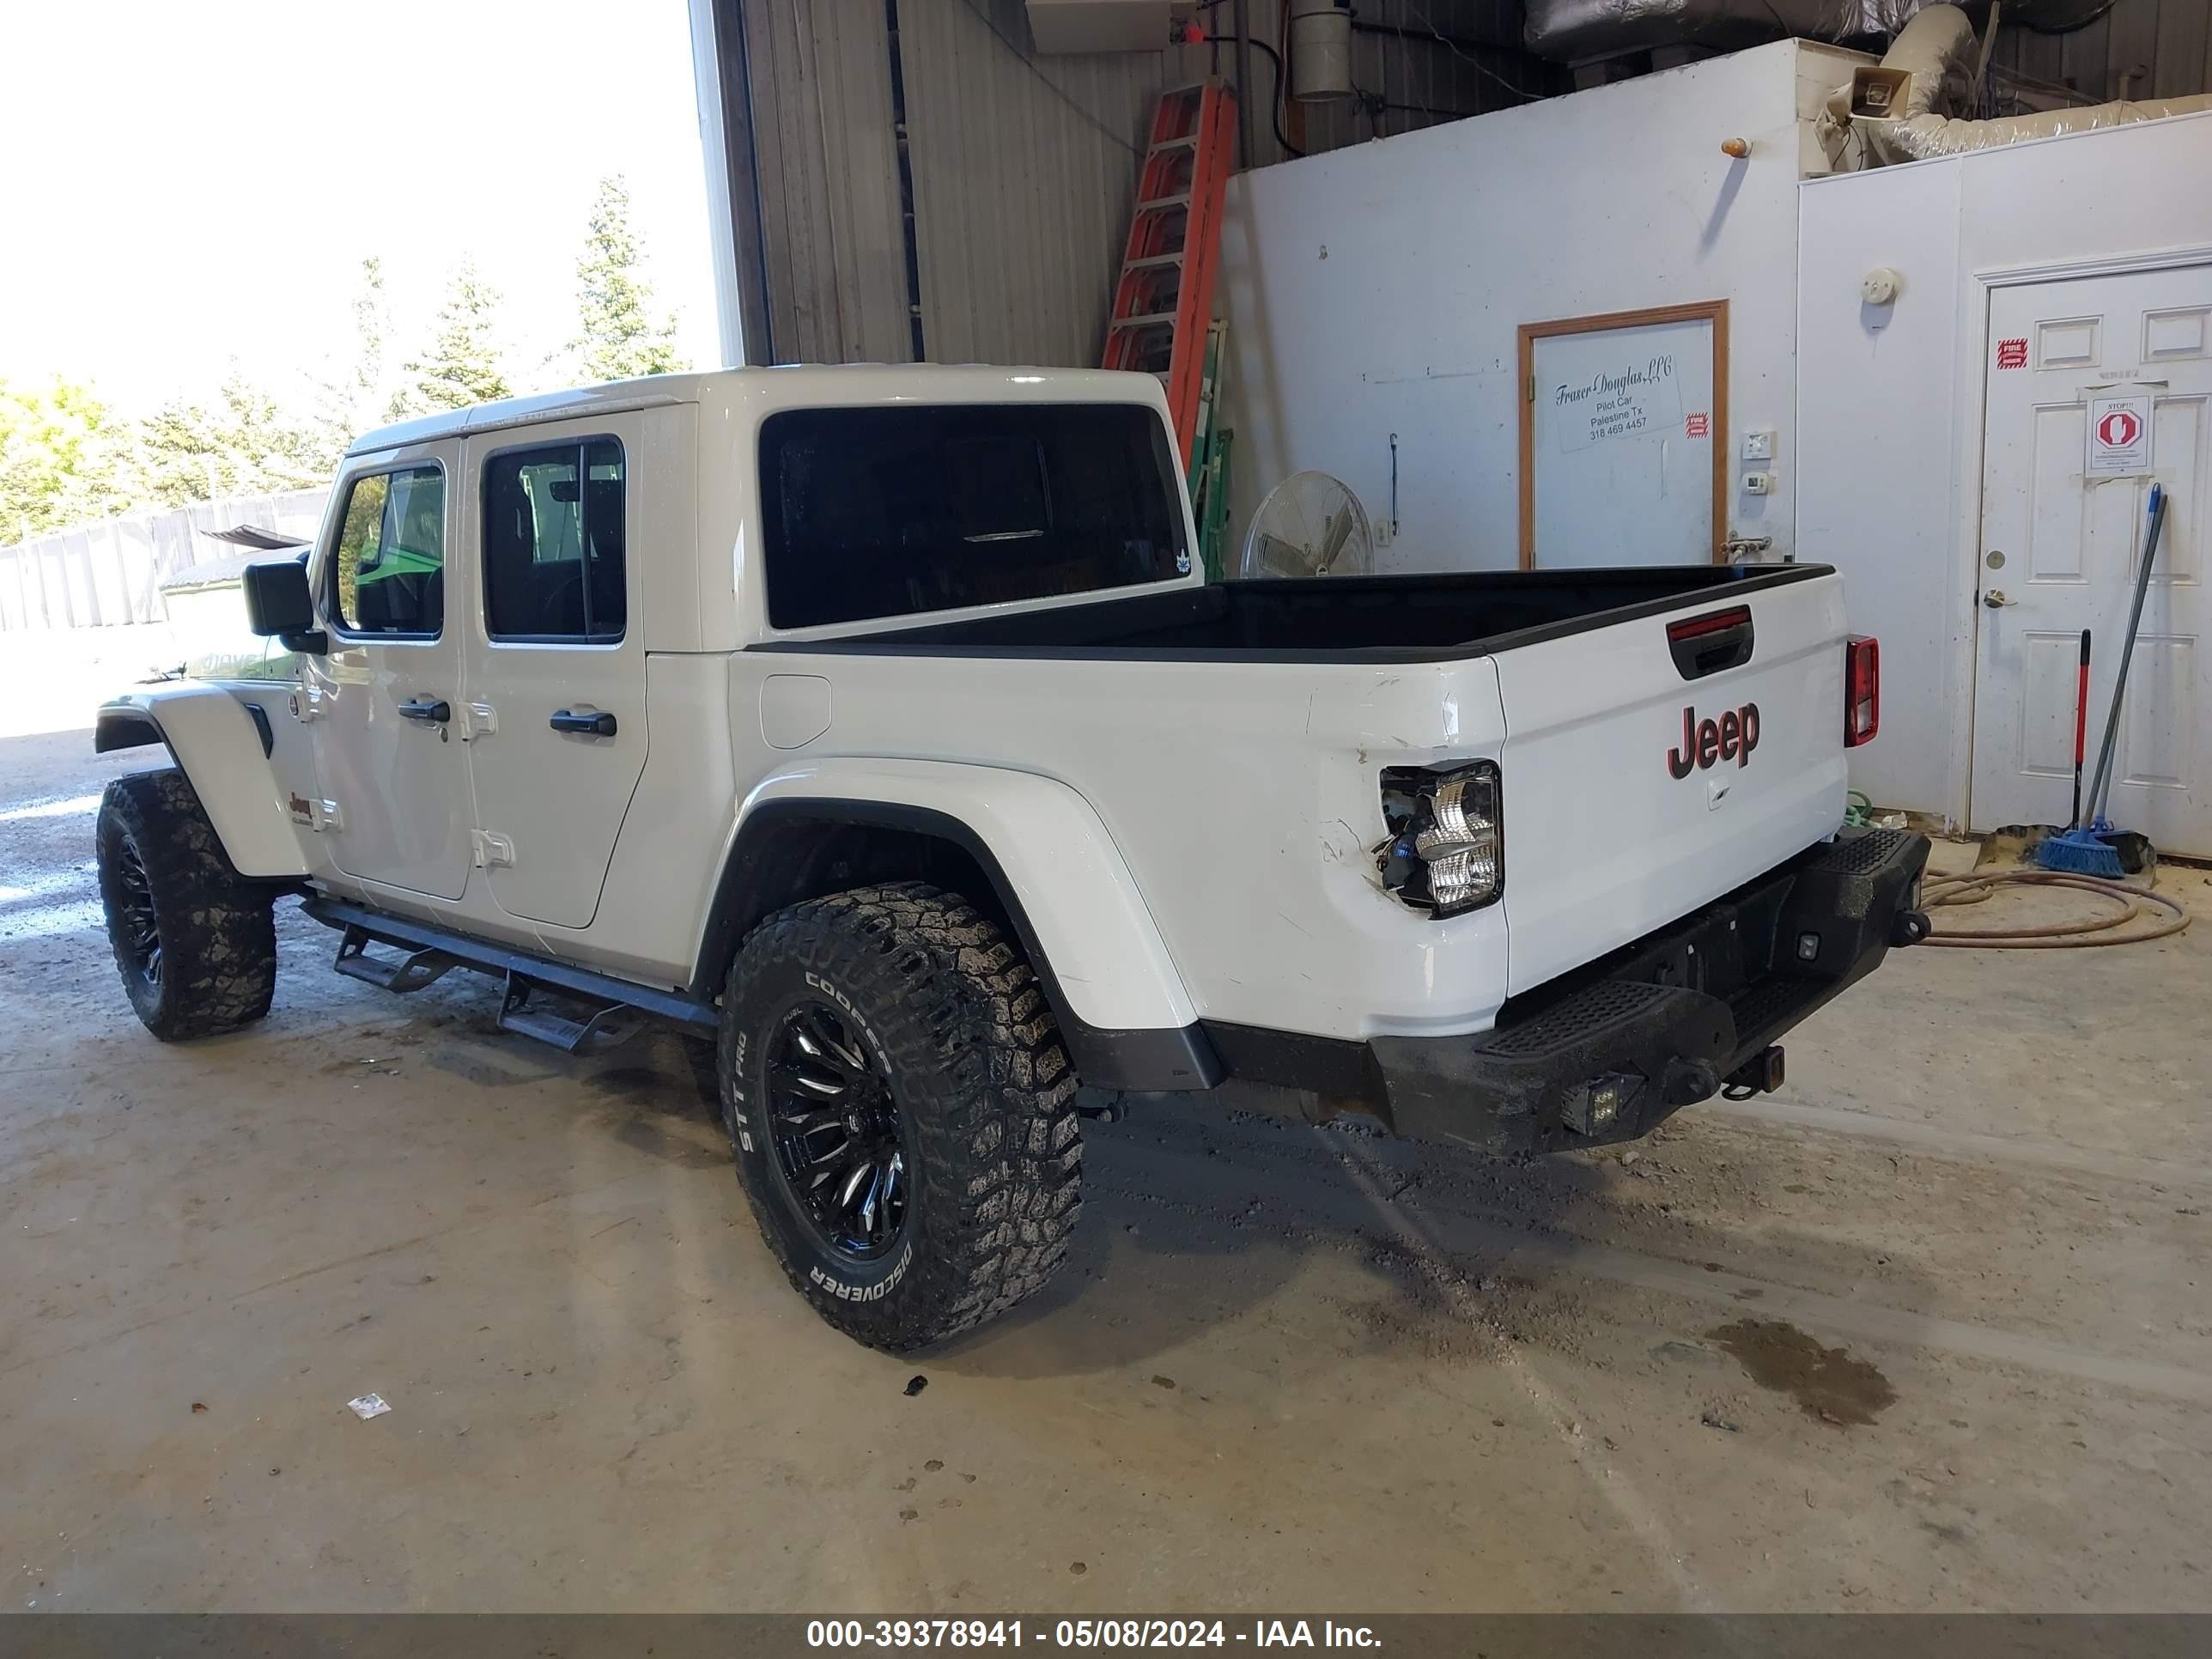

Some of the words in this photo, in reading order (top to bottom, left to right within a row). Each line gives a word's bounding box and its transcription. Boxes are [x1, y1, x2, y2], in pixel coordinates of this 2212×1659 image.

[1556, 384, 1592, 406] Fraser
[1590, 410, 1630, 428] Palestine
[1631, 406, 1643, 416] Tx
[1596, 401, 1615, 412] Pilot
[1617, 396, 1633, 407] Car
[1589, 428, 1606, 441] 318
[1607, 423, 1624, 435] 469
[1626, 417, 1647, 431] 4457
[1667, 702, 1760, 780] Jeep
[805, 971, 892, 1074] COOPER
[735, 1030, 747, 1079] PRO
[732, 1080, 754, 1152] STT
[810, 1239, 913, 1303] DISCOVERER
